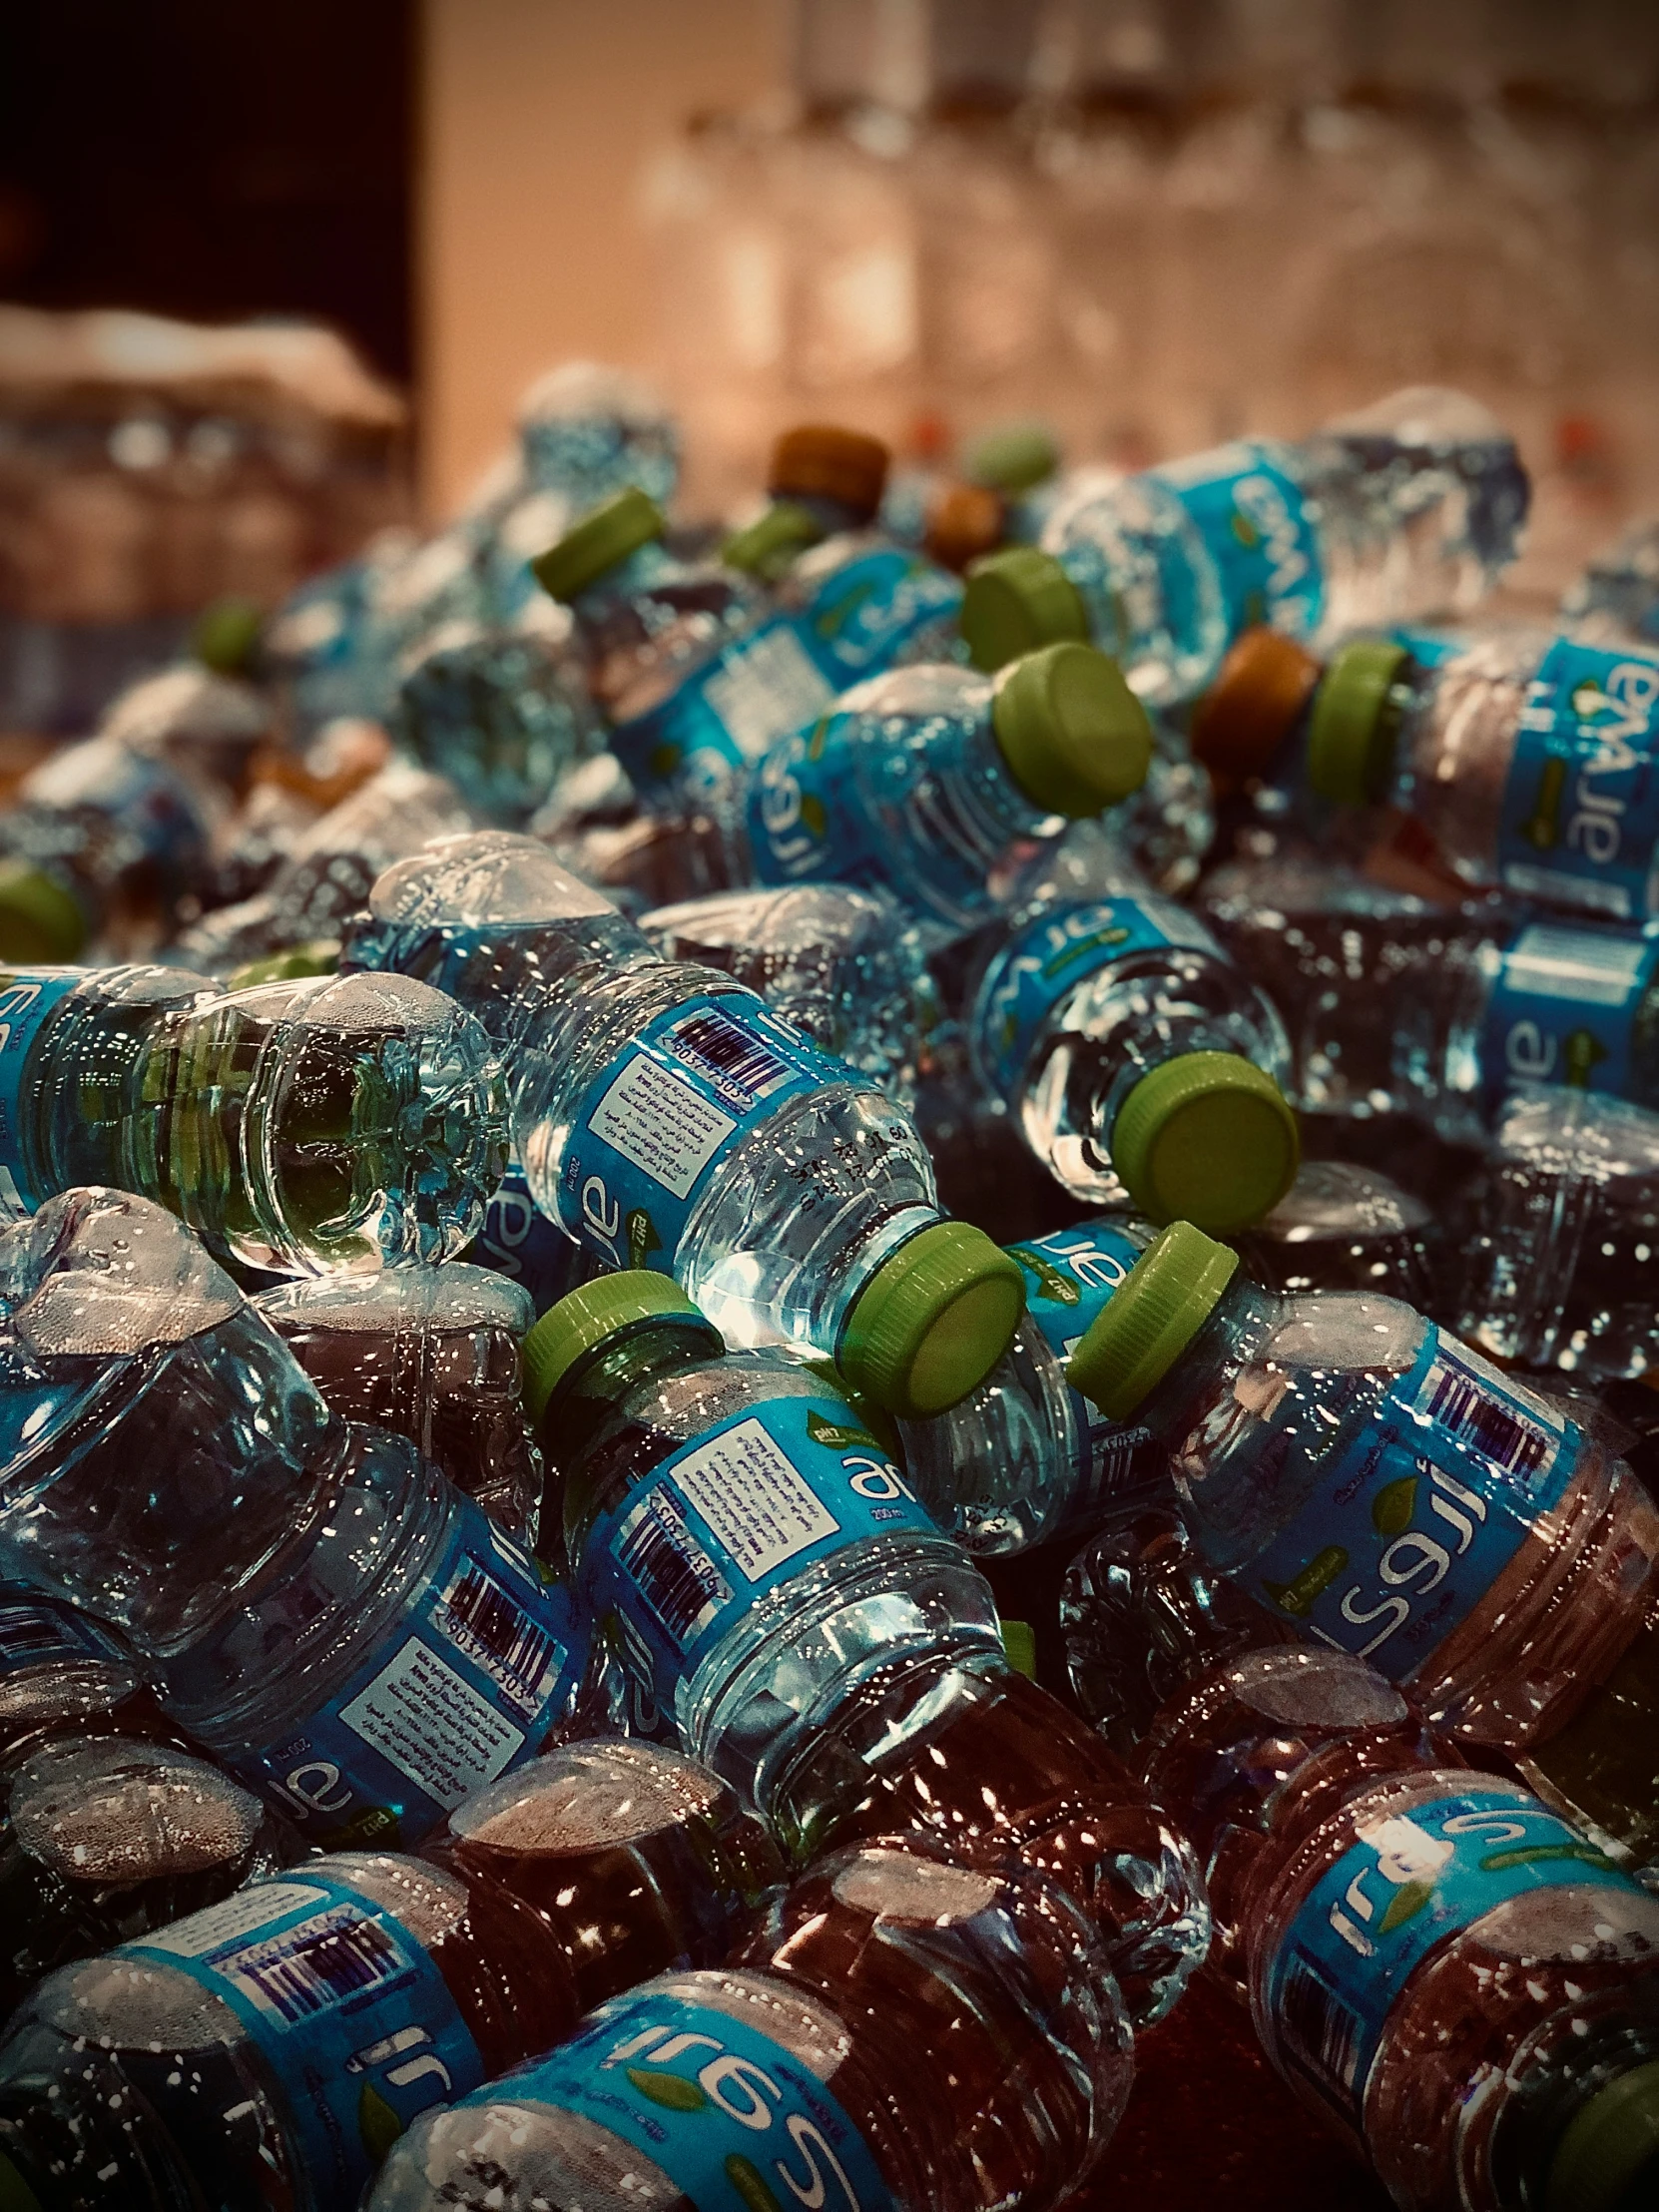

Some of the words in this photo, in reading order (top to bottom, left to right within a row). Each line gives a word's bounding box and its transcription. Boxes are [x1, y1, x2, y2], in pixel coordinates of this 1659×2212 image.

[1567, 663, 1659, 863] arwa
[670, 1040, 708, 1073] 9037
[707, 1067, 745, 1100] 7303
[568, 1156, 581, 1178] 200
[653, 1503, 691, 1546] 7303
[683, 1547, 723, 1589] 9037
[444, 1619, 486, 1661] 9037
[486, 1659, 529, 1702] 7303
